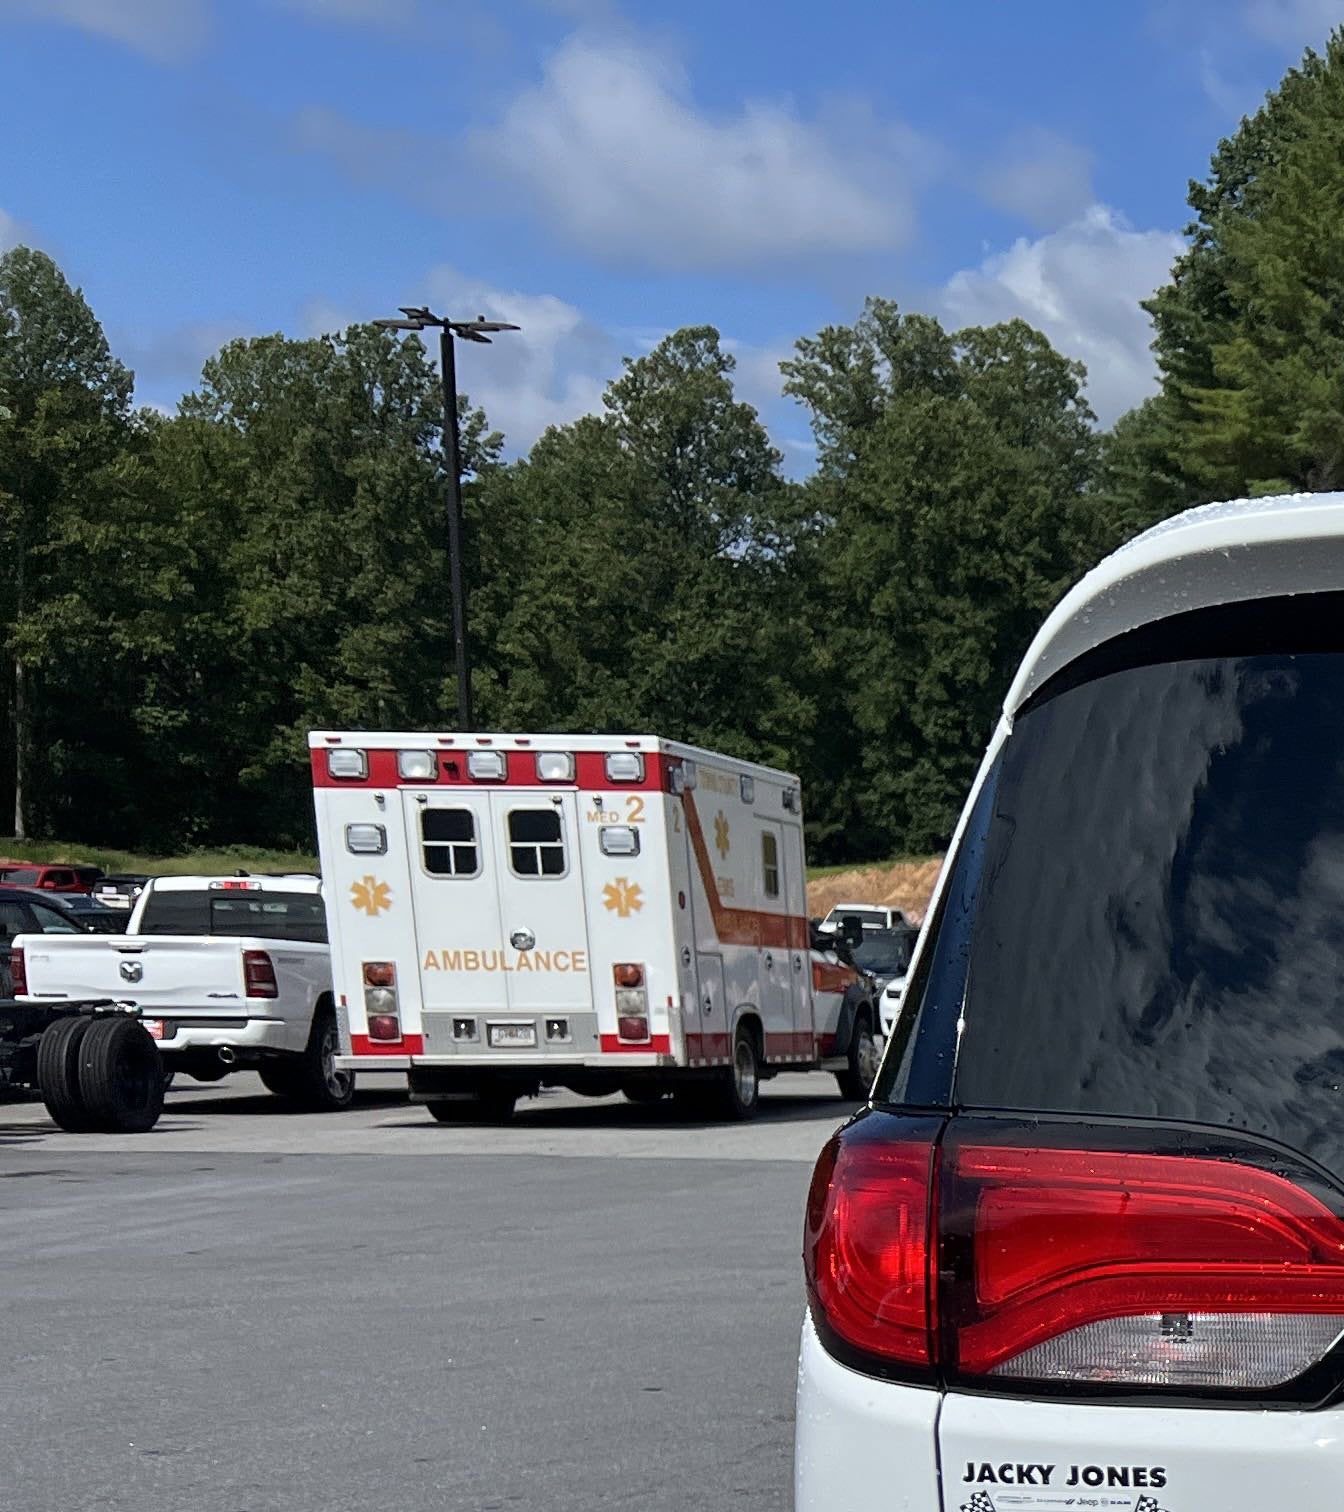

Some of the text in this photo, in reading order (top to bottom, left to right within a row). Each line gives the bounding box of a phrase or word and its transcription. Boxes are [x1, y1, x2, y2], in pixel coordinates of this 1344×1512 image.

[586, 796, 646, 823] MED 2
[423, 950, 587, 972] AMBULANCE
[963, 1462, 1168, 1488] JACKY JONES
